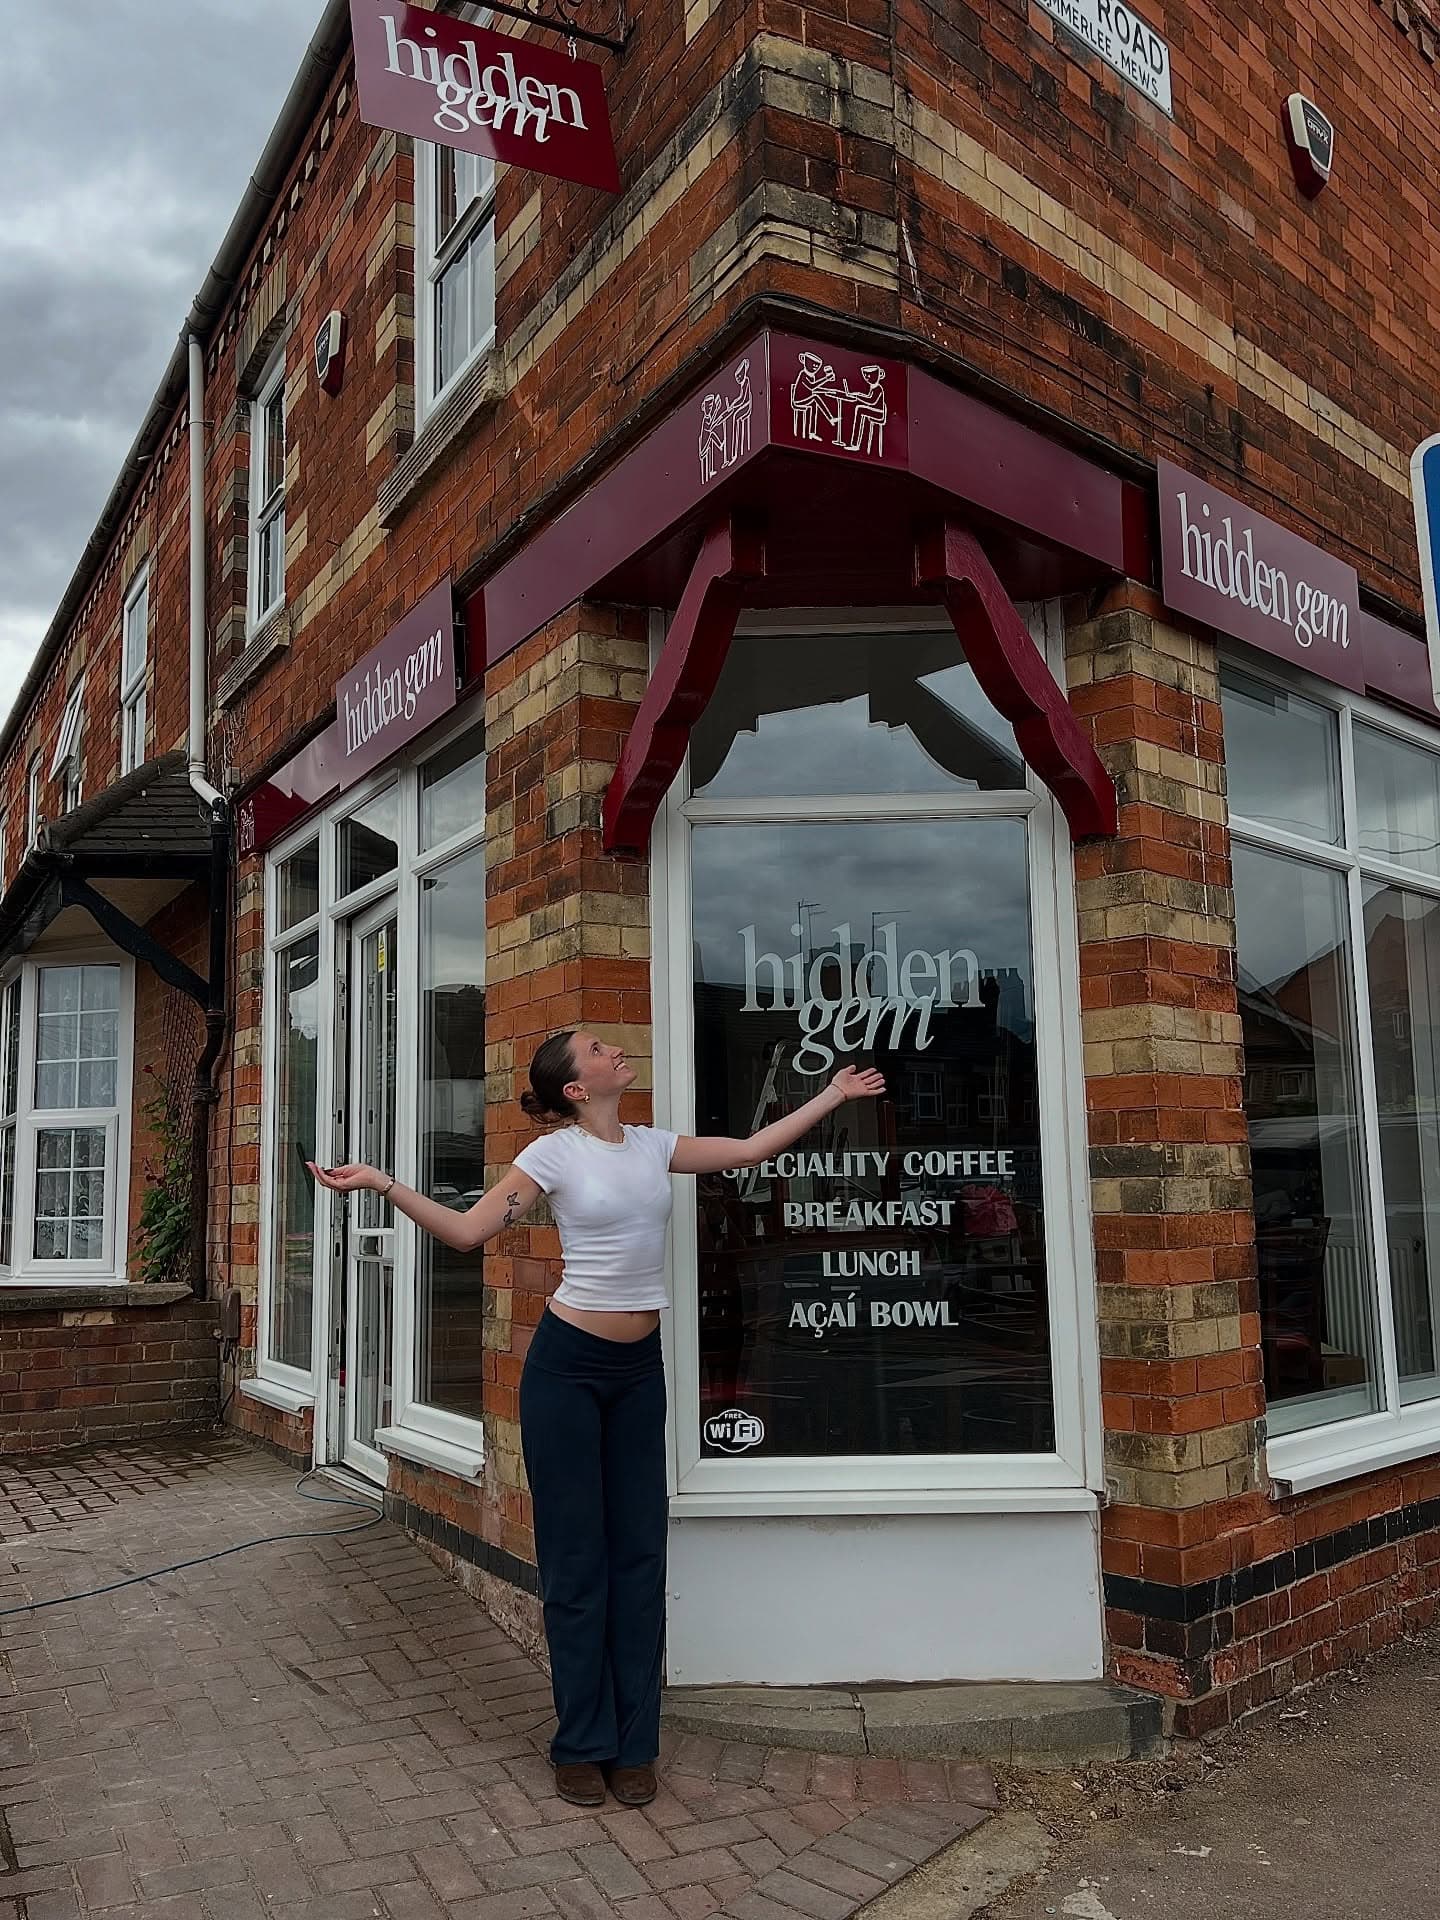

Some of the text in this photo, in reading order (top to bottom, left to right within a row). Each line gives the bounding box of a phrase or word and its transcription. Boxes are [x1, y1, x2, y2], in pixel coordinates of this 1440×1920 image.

[379, 15, 588, 130] hidden
[1042, 0, 1159, 98] MMERLEE MEWS
[1097, 0, 1163, 75] ROAD
[433, 80, 550, 143] gem
[1176, 491, 1350, 649] hidden gem
[344, 629, 443, 757] hidden gem
[737, 921, 986, 1012] hidden
[791, 986, 935, 1075] gem
[903, 1150, 1016, 1176] COFFEE
[783, 1200, 956, 1227] BREAKFAST
[822, 1250, 921, 1277] LUNCH
[788, 1292, 959, 1338] AÇAÍ BOWL
